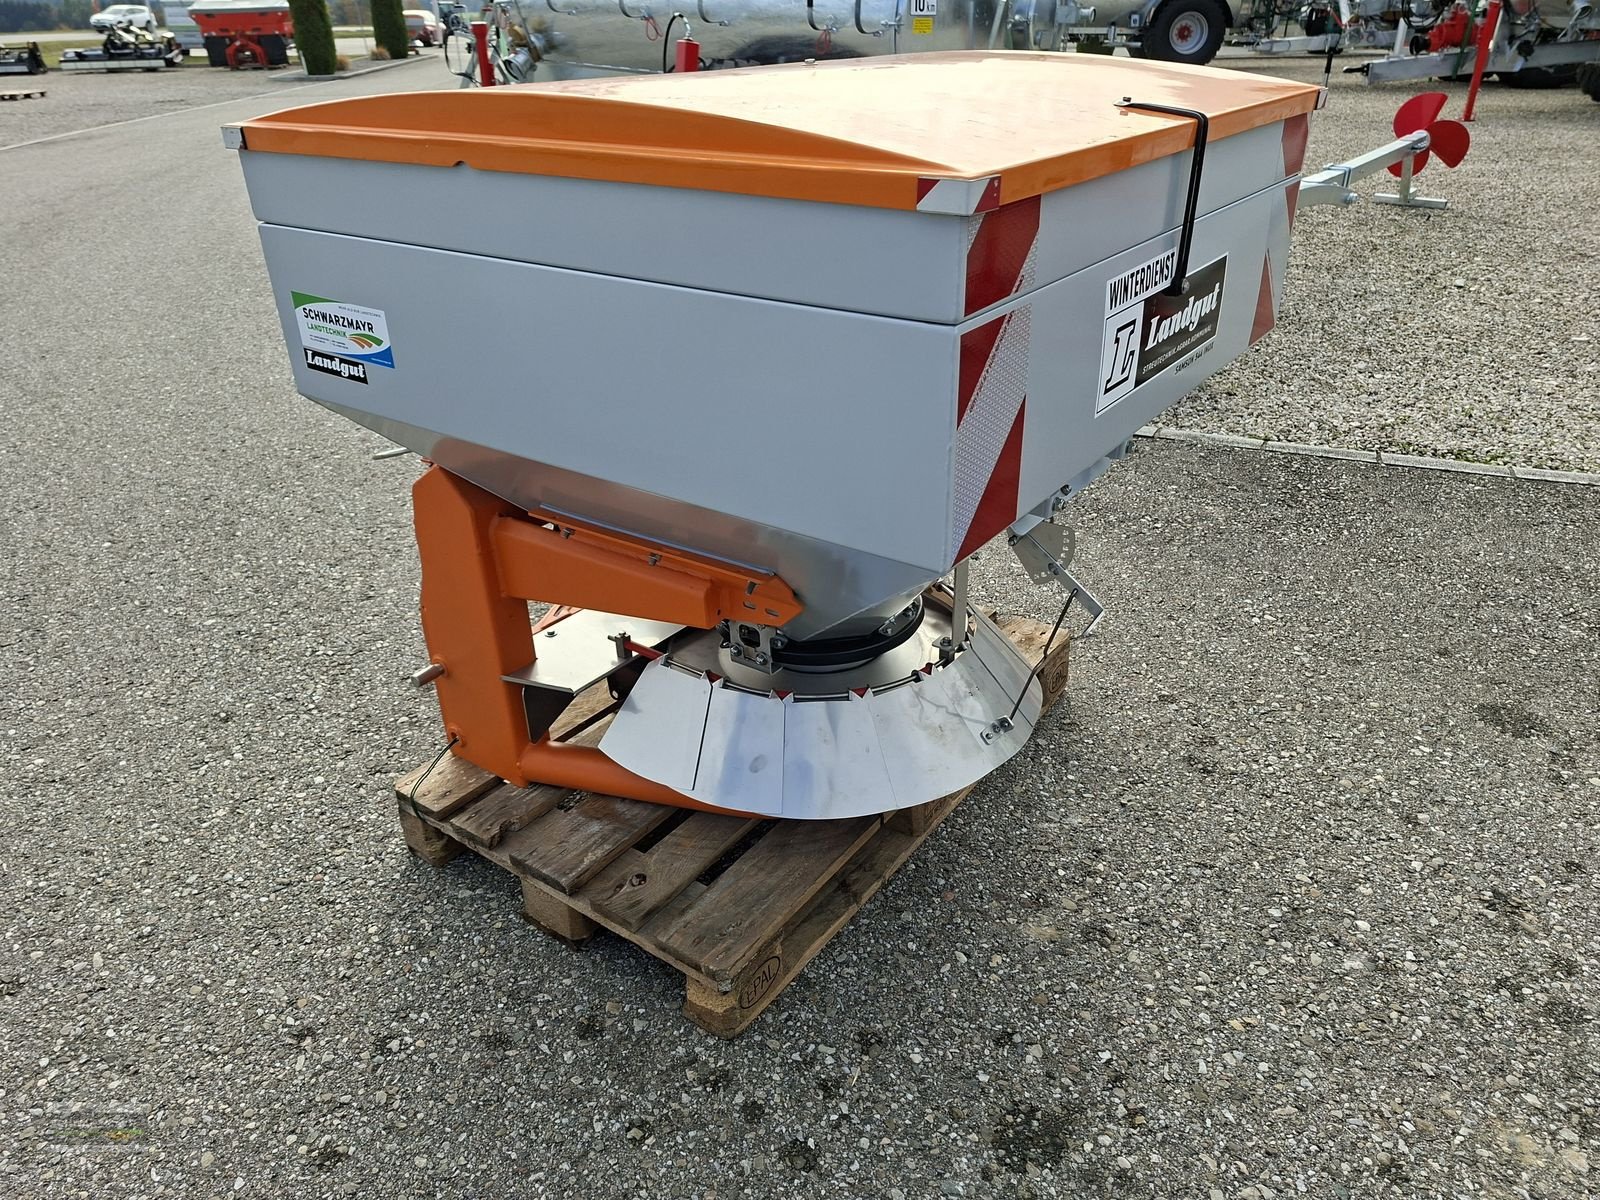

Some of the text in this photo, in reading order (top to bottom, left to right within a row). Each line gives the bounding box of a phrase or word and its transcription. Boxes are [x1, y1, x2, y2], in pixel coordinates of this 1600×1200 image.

[1109, 252, 1174, 310] WINTERDIENST
[303, 307, 374, 333] SCHWARZMAYR
[306, 323, 347, 338] LANDTECHNIK
[1145, 282, 1220, 351] Landgut
[305, 350, 365, 377] Landgut
[1103, 319, 1136, 395] L
[746, 965, 776, 1003] EPAL
